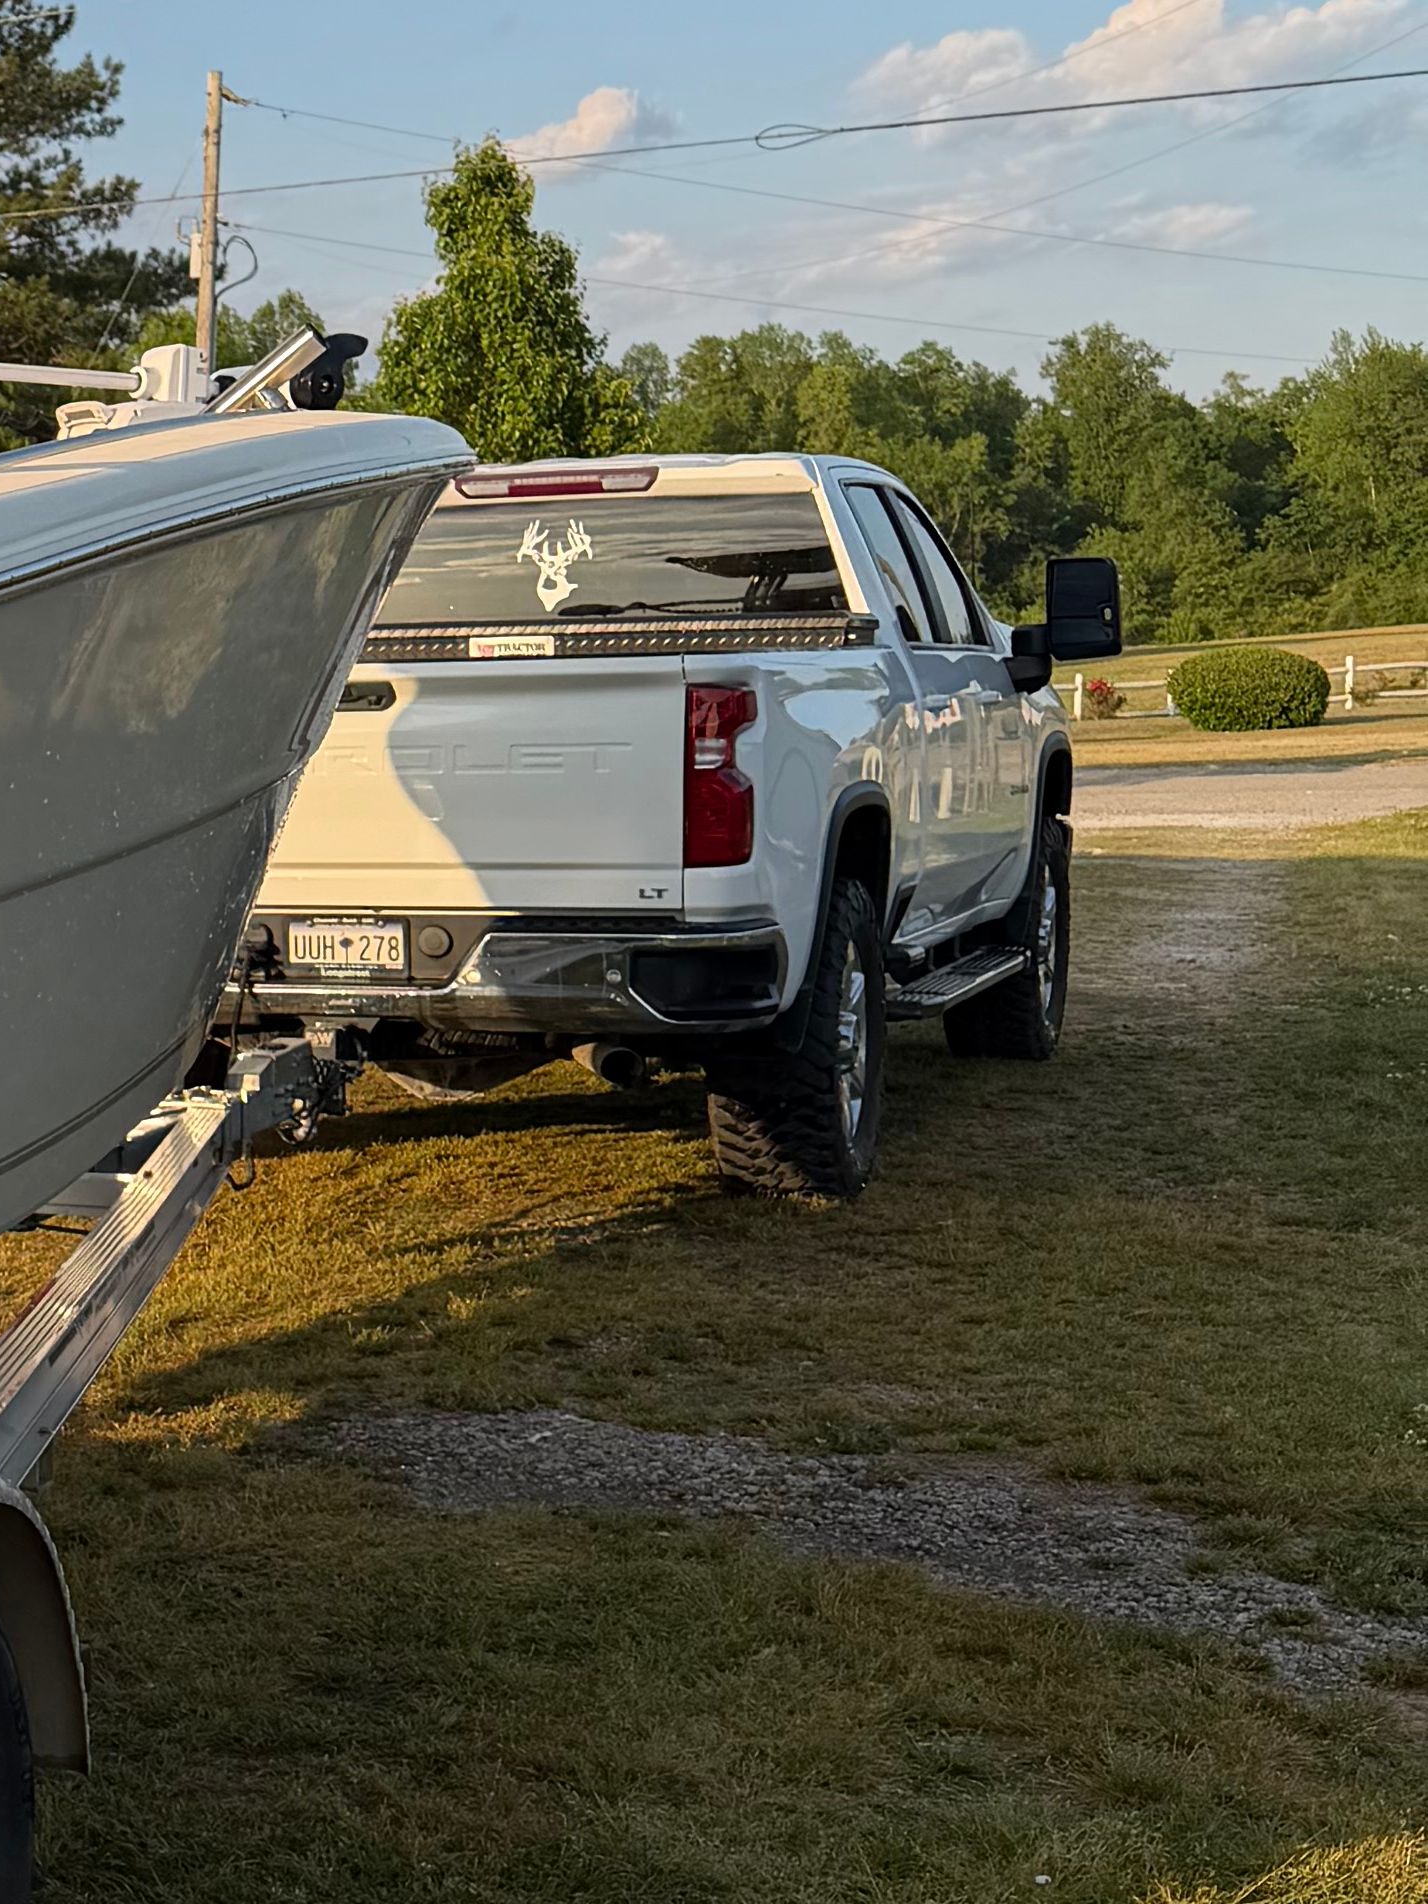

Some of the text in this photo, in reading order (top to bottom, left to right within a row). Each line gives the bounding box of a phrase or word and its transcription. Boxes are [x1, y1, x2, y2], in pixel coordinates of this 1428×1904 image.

[312, 741, 634, 776] ROLET
[638, 887, 669, 899] LT
[294, 934, 400, 961] UUH 278
